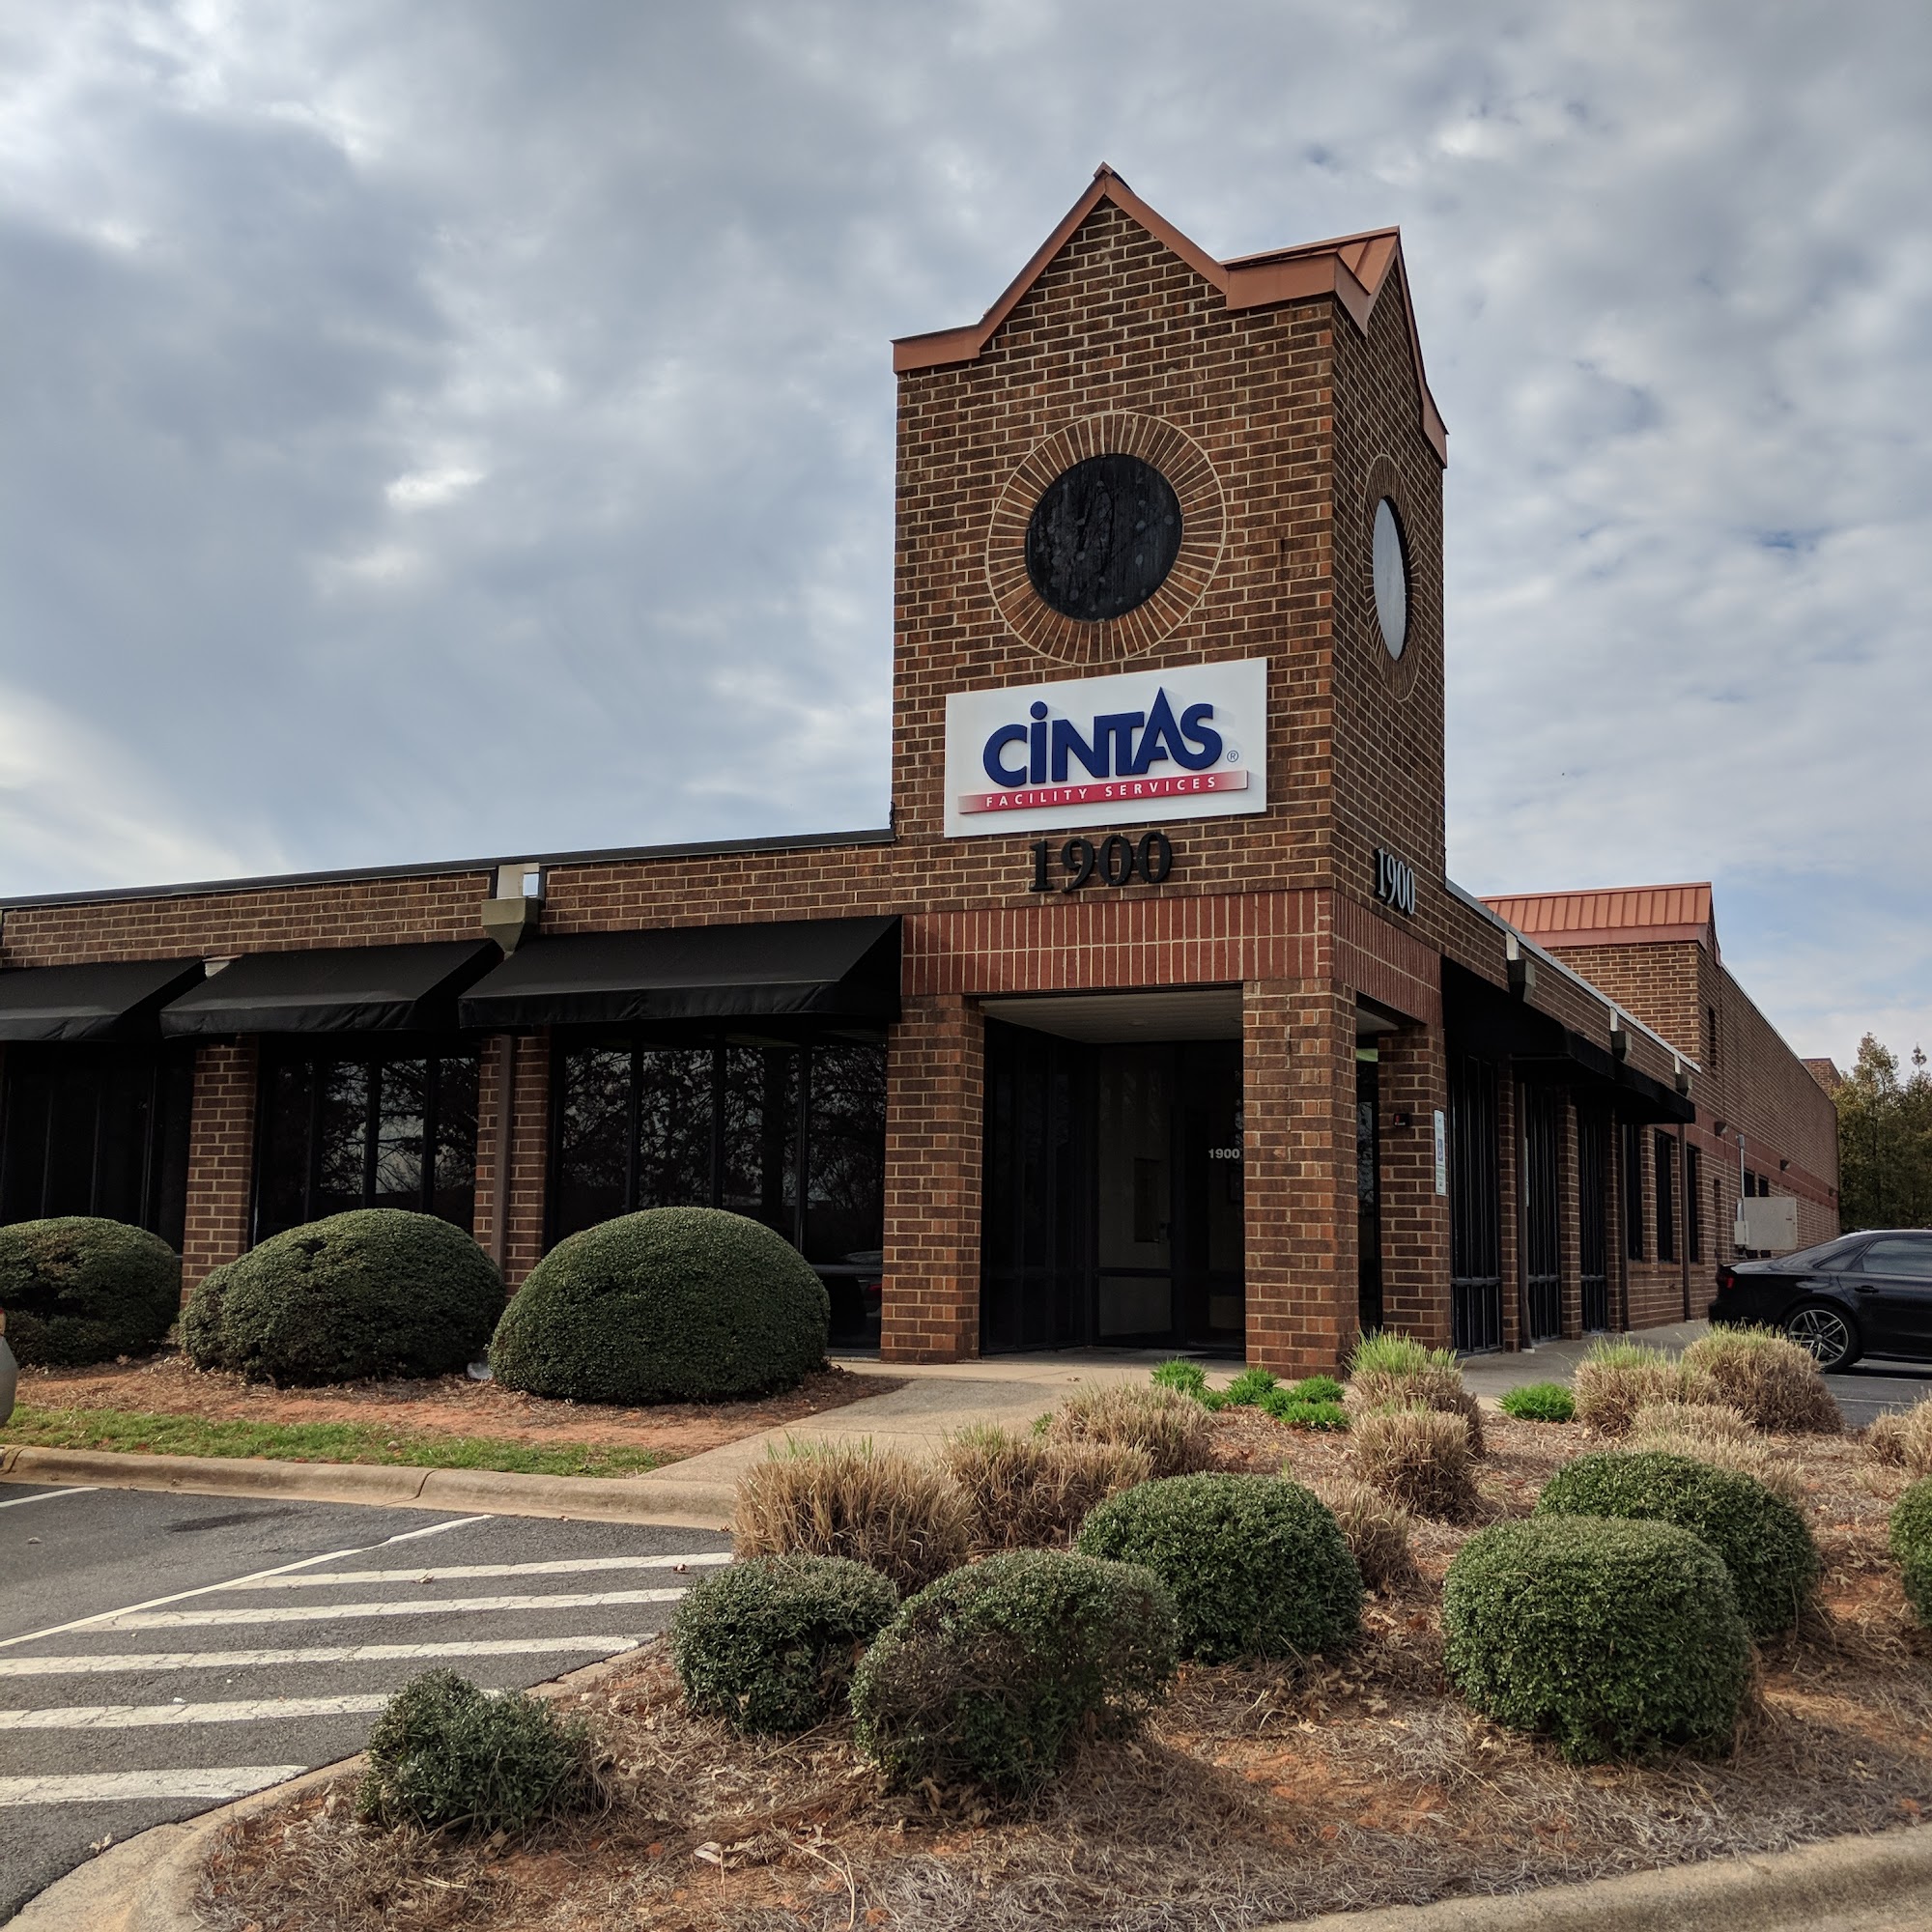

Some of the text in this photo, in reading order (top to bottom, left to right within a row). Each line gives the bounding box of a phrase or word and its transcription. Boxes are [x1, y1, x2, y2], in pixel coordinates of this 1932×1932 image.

[985, 776, 1216, 808] FACILITY SERVICES
[1029, 831, 1173, 893] 1900
[1375, 847, 1415, 916] 1900
[1208, 1148, 1240, 1159] 1900
